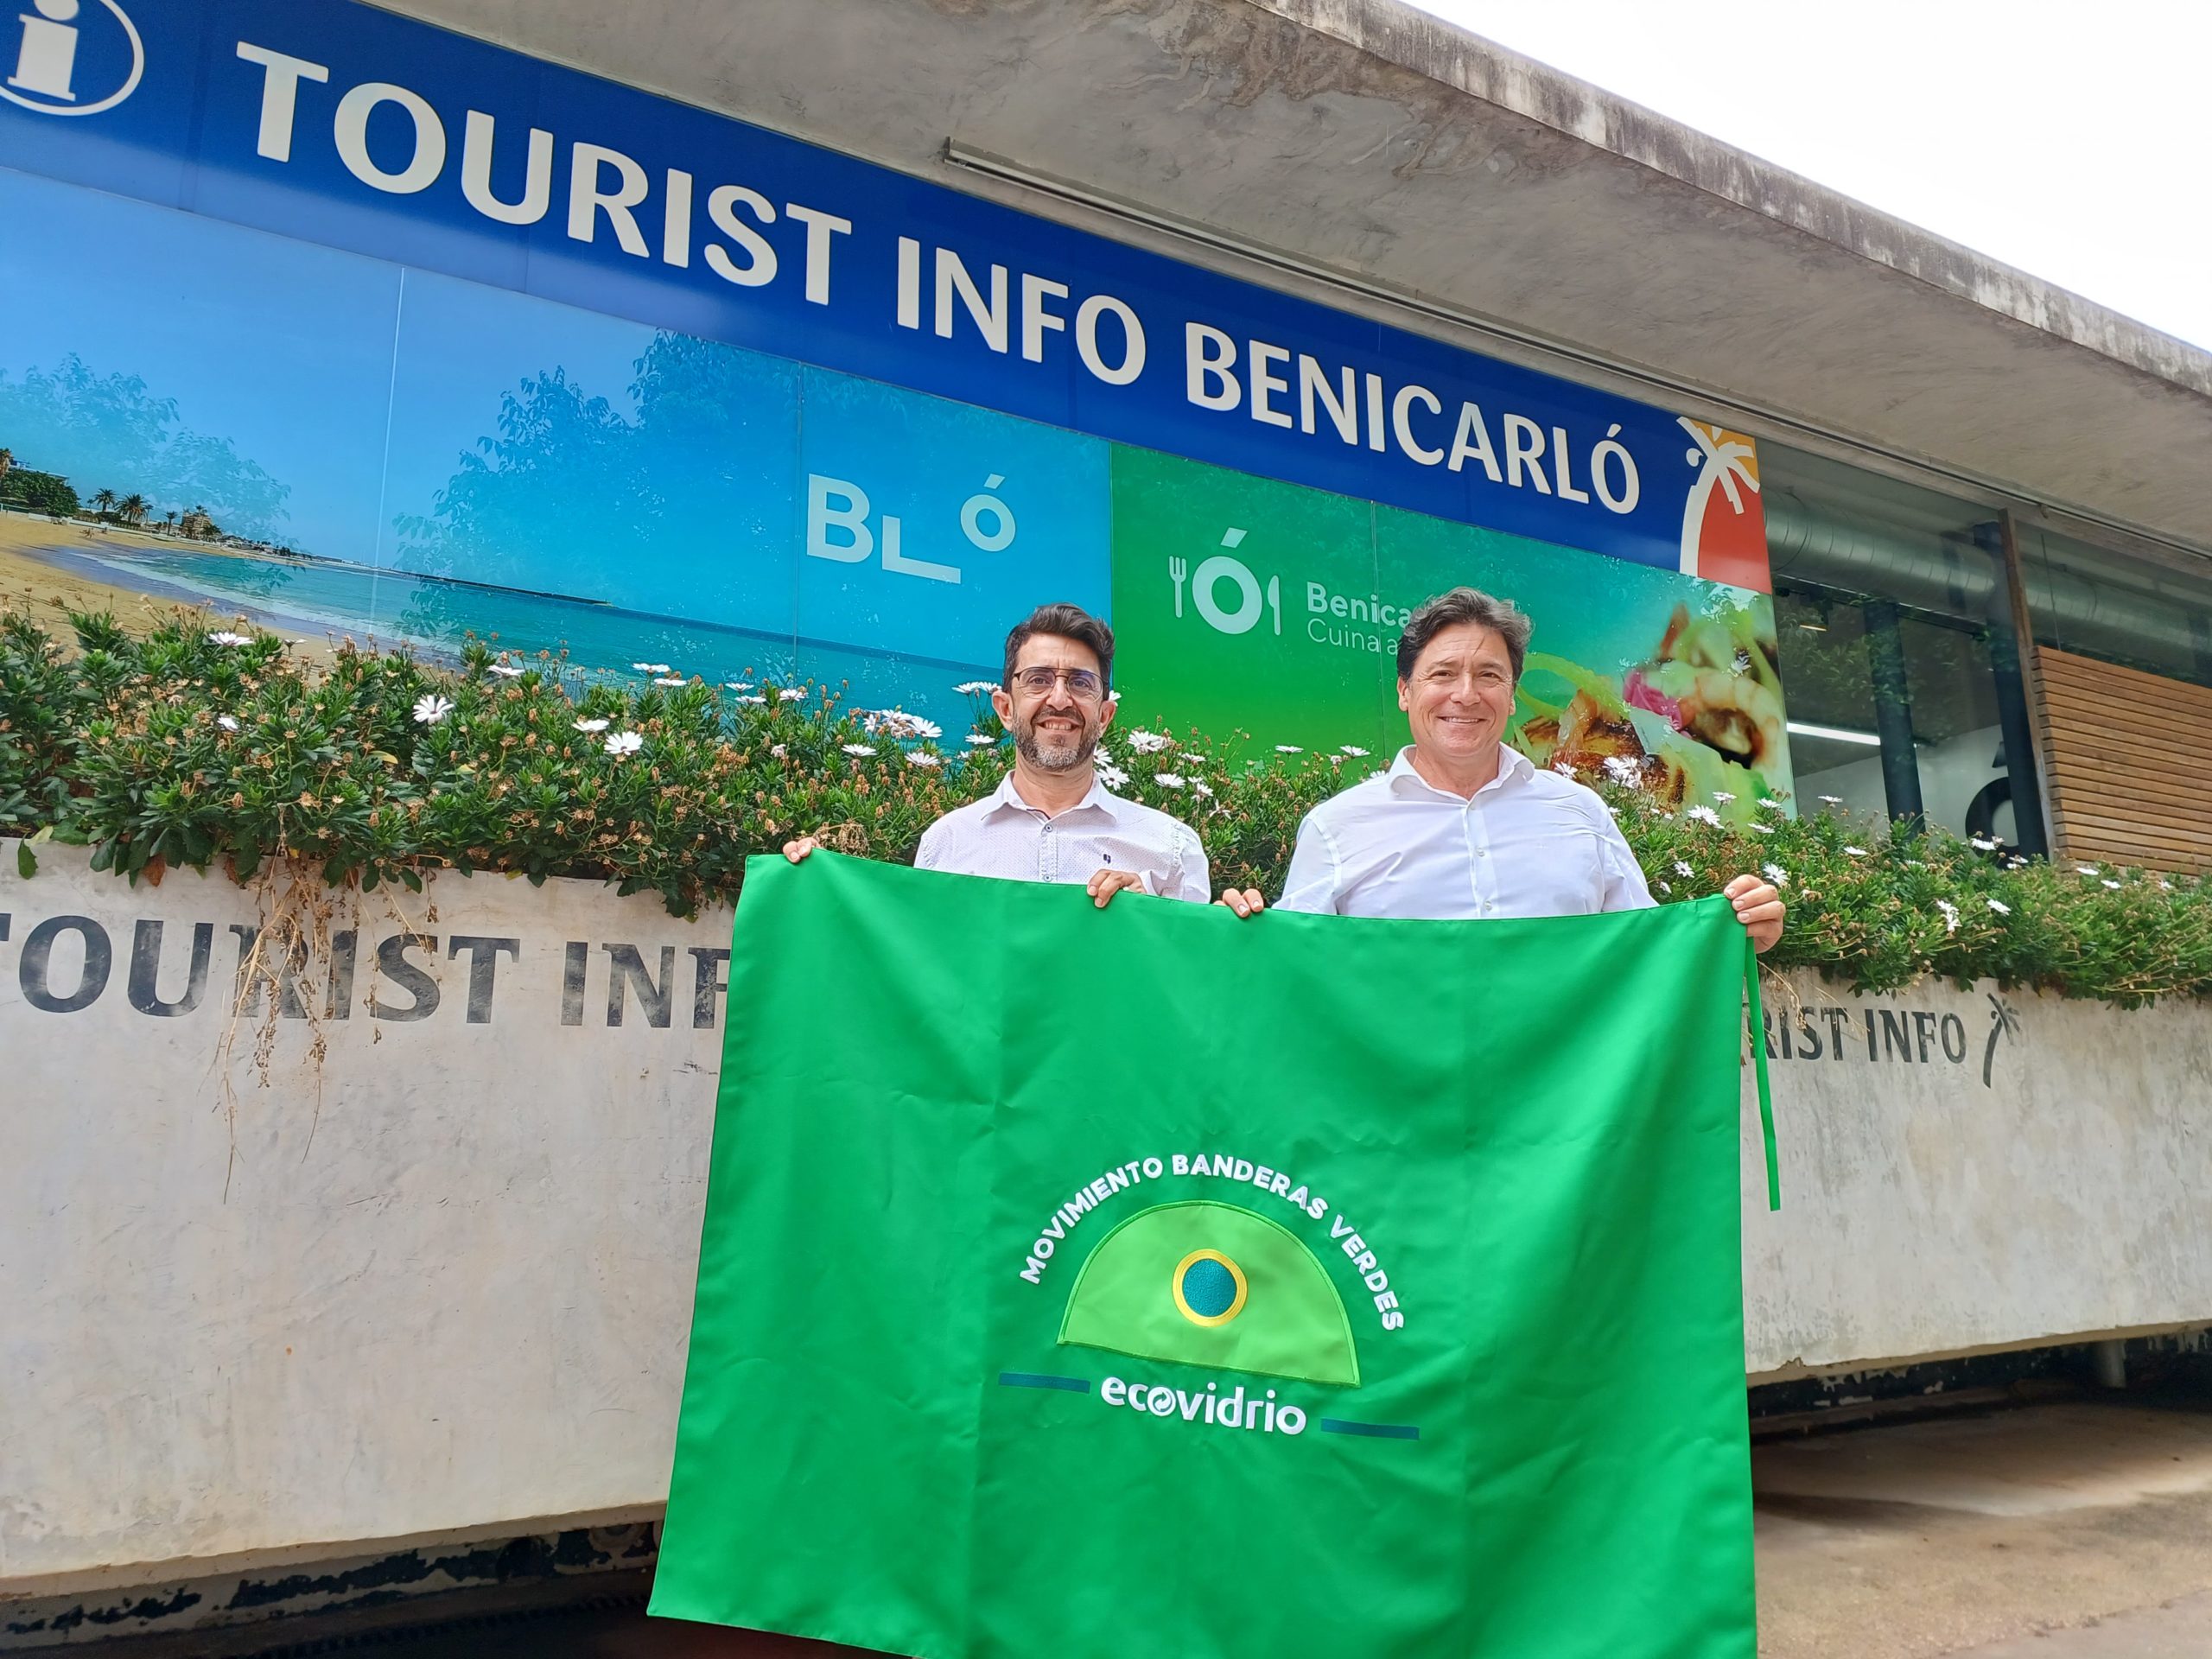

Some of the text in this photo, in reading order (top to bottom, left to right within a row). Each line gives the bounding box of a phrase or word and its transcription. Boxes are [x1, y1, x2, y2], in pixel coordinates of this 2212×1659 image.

[236, 41, 1641, 514] TOURIST INFO BENICARLÓ
[1307, 618, 1380, 653] Cuina
[0, 912, 521, 1025] OURIST
[1864, 1008, 1967, 1065] INFO
[1019, 1154, 1405, 1332] MOVIMIENTO BANDERAS VERDES
[1100, 1376, 1307, 1436] ecovidrio
